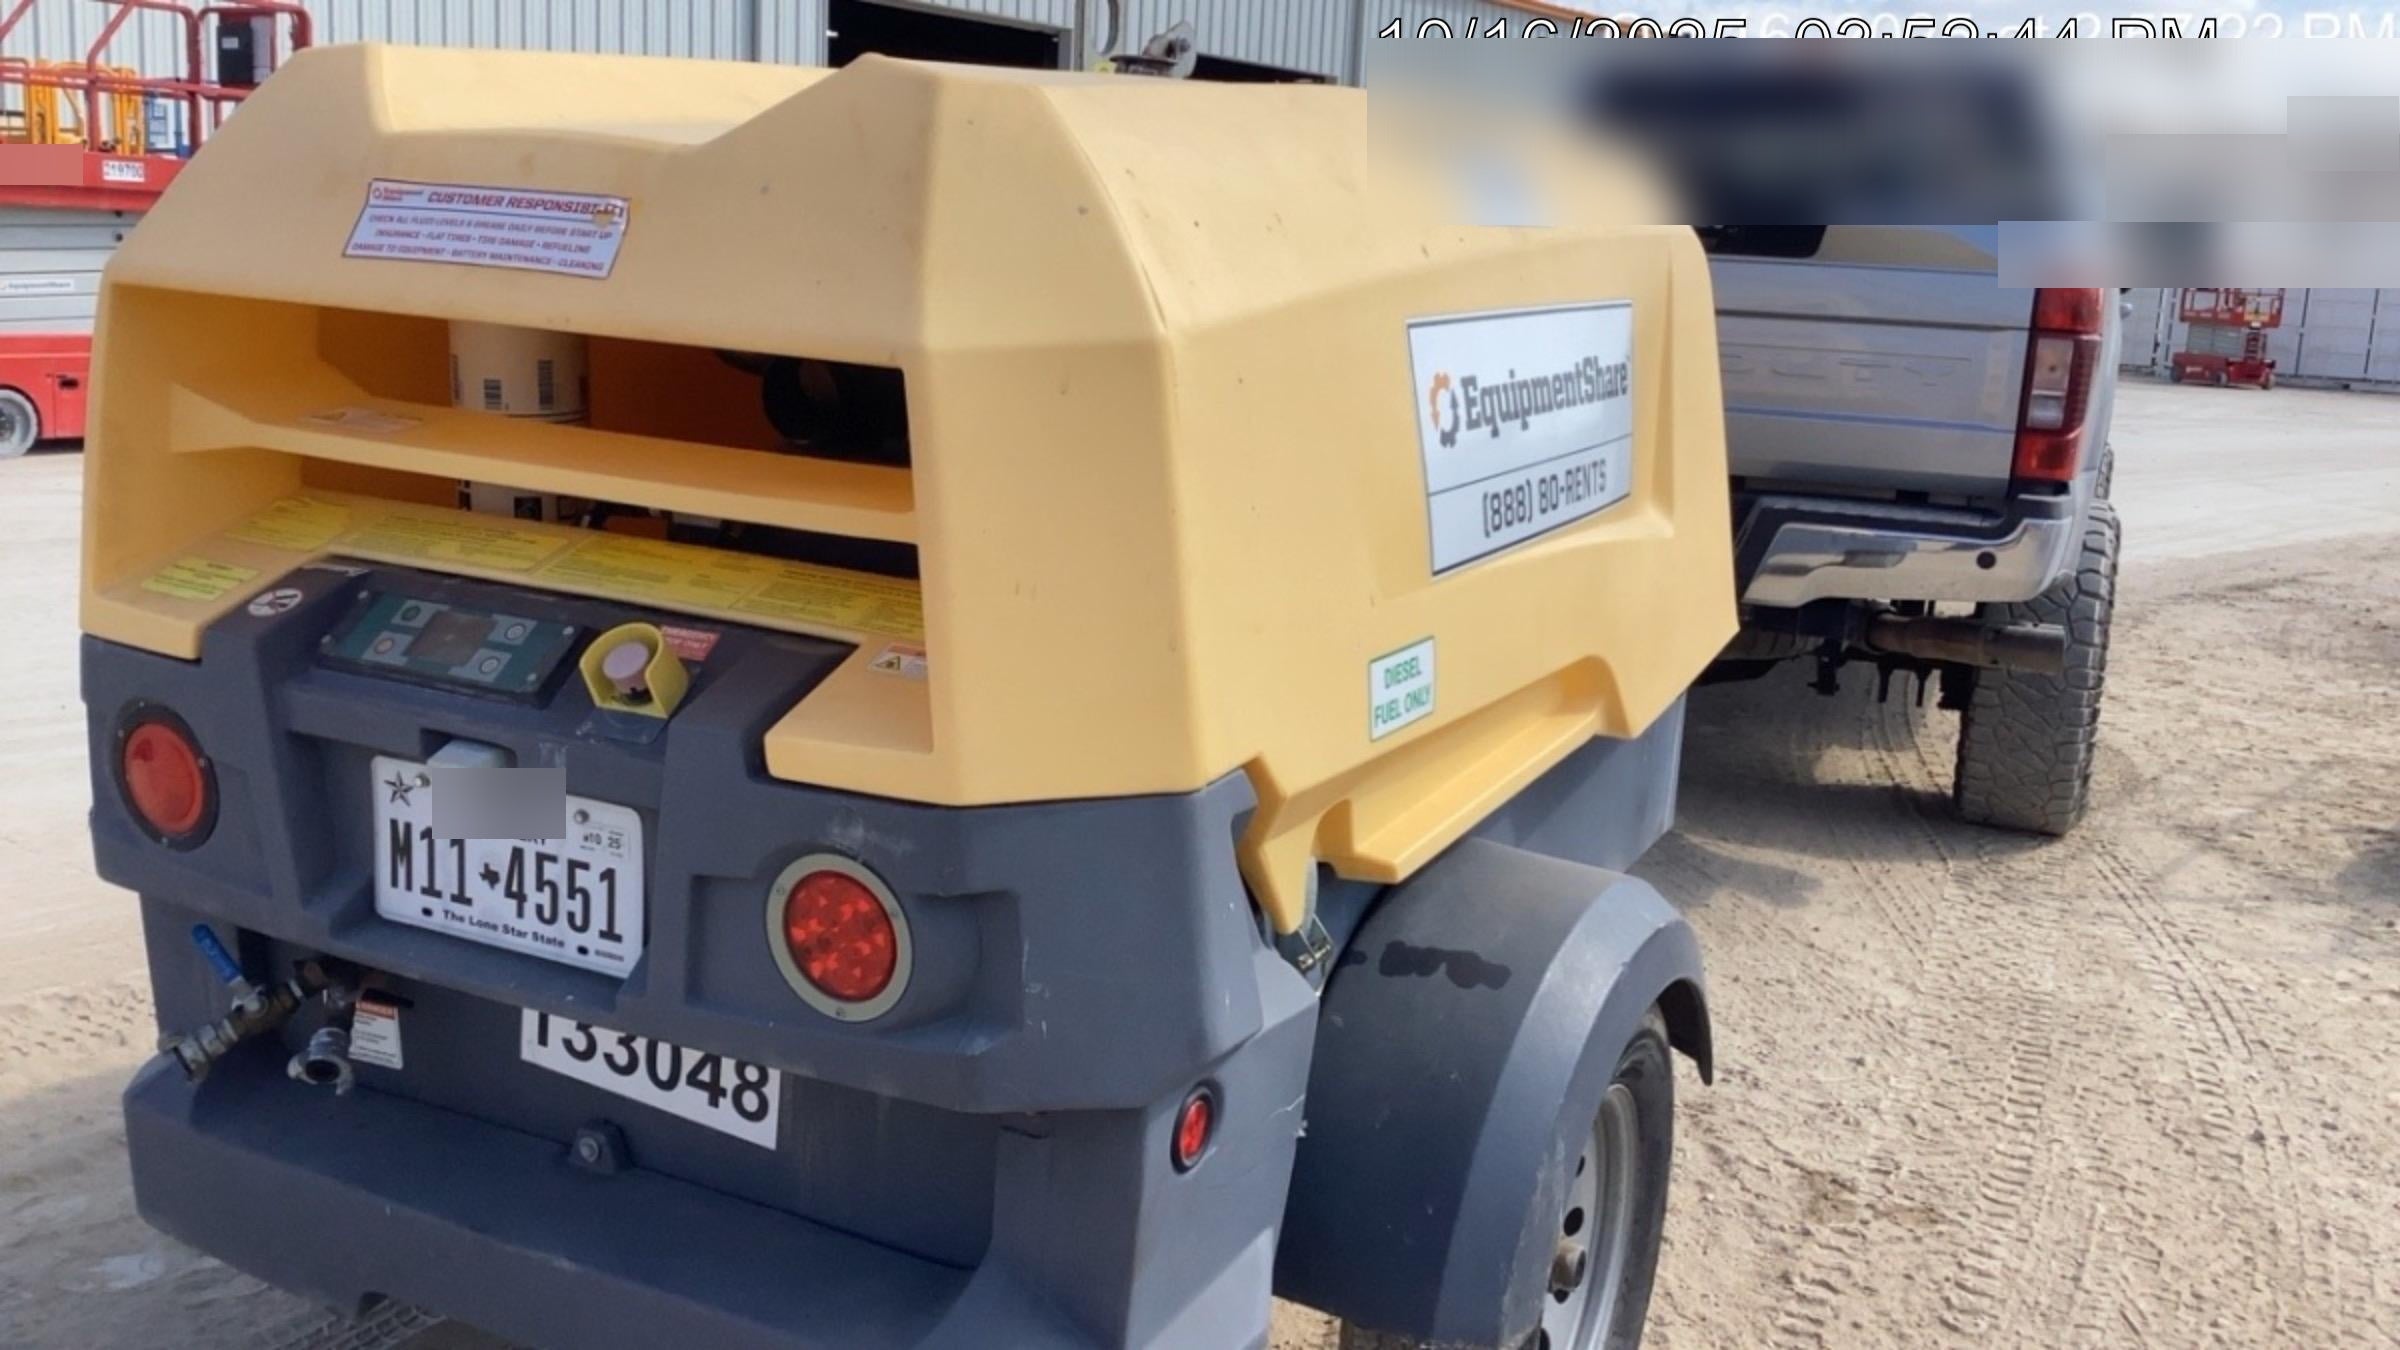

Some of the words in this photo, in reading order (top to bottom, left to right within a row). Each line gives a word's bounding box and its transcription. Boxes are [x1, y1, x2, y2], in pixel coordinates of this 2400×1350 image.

[427, 191, 505, 207] CUSTOMER
[1461, 355, 1628, 439] EquipmentShare
[1481, 478, 1533, 538] (888)
[1537, 459, 1607, 515] 80-RENTS
[1384, 656, 1421, 689] DIESEL
[1374, 698, 1402, 729] FUEL
[1404, 683, 1432, 713] ONLY
[390, 817, 473, 907] M11
[503, 845, 623, 944] 4551
[443, 909, 465, 923] The
[468, 915, 499, 932] Lone
[501, 923, 528, 939] Star
[532, 931, 565, 949] State
